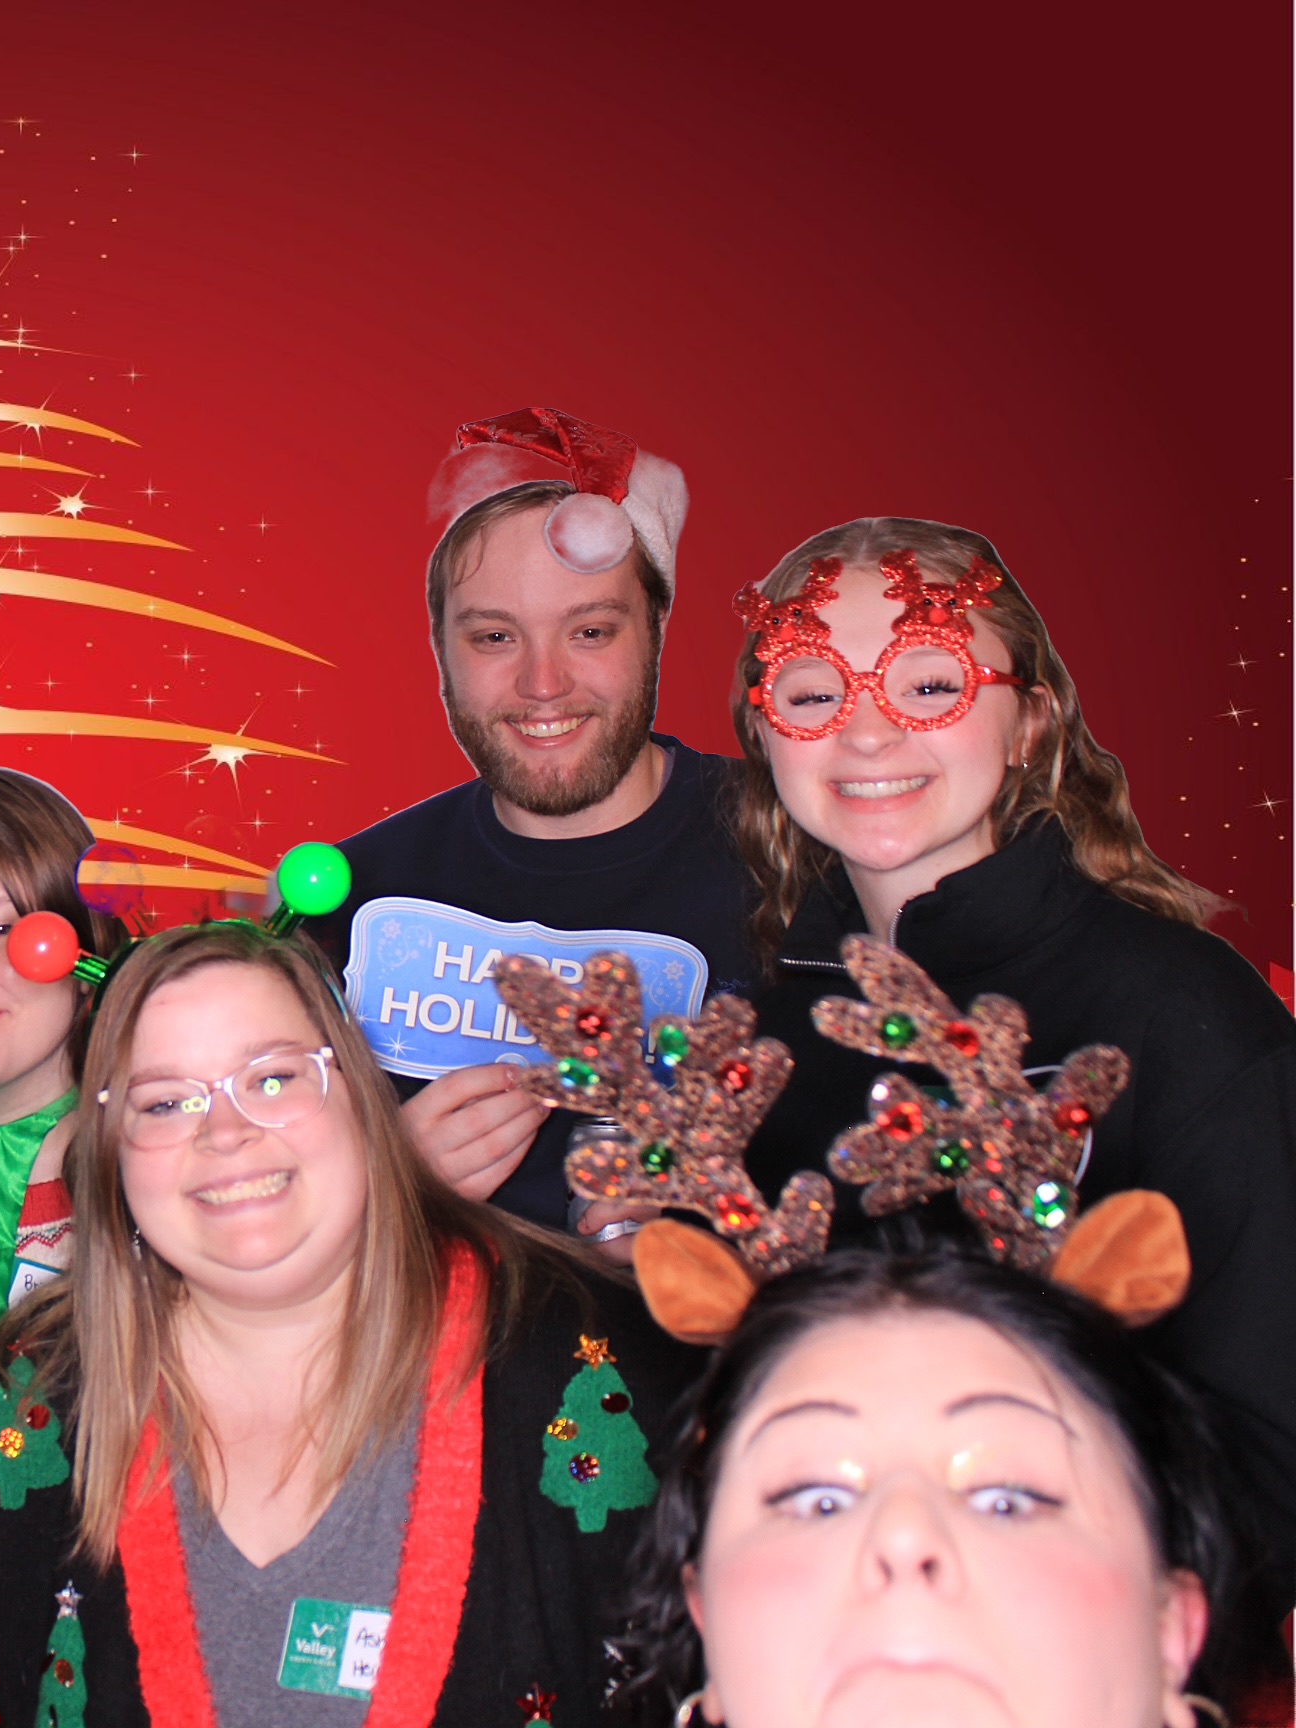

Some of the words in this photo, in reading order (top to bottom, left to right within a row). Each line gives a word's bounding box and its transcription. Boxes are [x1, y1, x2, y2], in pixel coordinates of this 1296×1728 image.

[433, 941, 584, 985] HAP
[380, 987, 658, 1064] HOLID!
[295, 1637, 336, 1660] Valley
[355, 1626, 387, 1648] Ash
